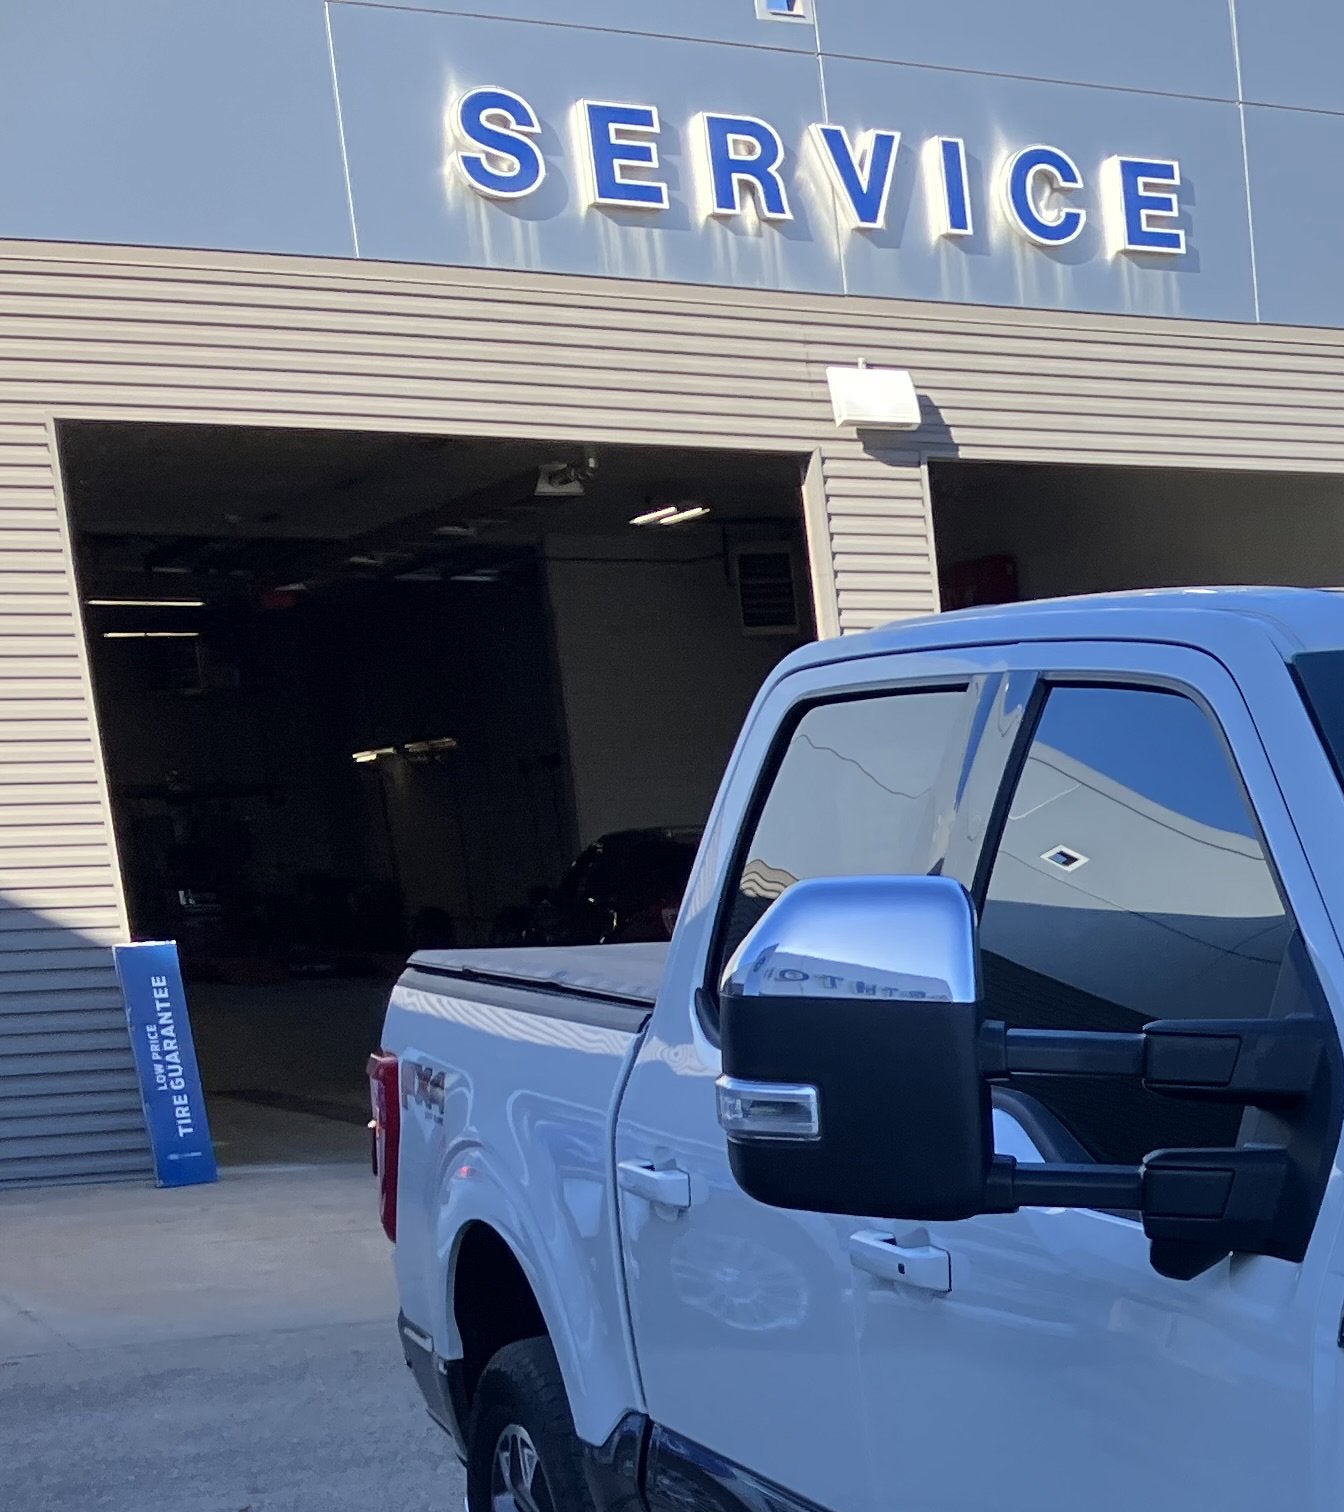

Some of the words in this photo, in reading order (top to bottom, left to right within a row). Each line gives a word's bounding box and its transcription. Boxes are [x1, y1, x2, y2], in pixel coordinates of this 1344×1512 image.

[452, 85, 1186, 255] SERVICE
[146, 1024, 161, 1061] PRICE
[151, 975, 186, 1091] GUARANTEE
[155, 1062, 168, 1091] LOW
[173, 1093, 194, 1137] TIRE
